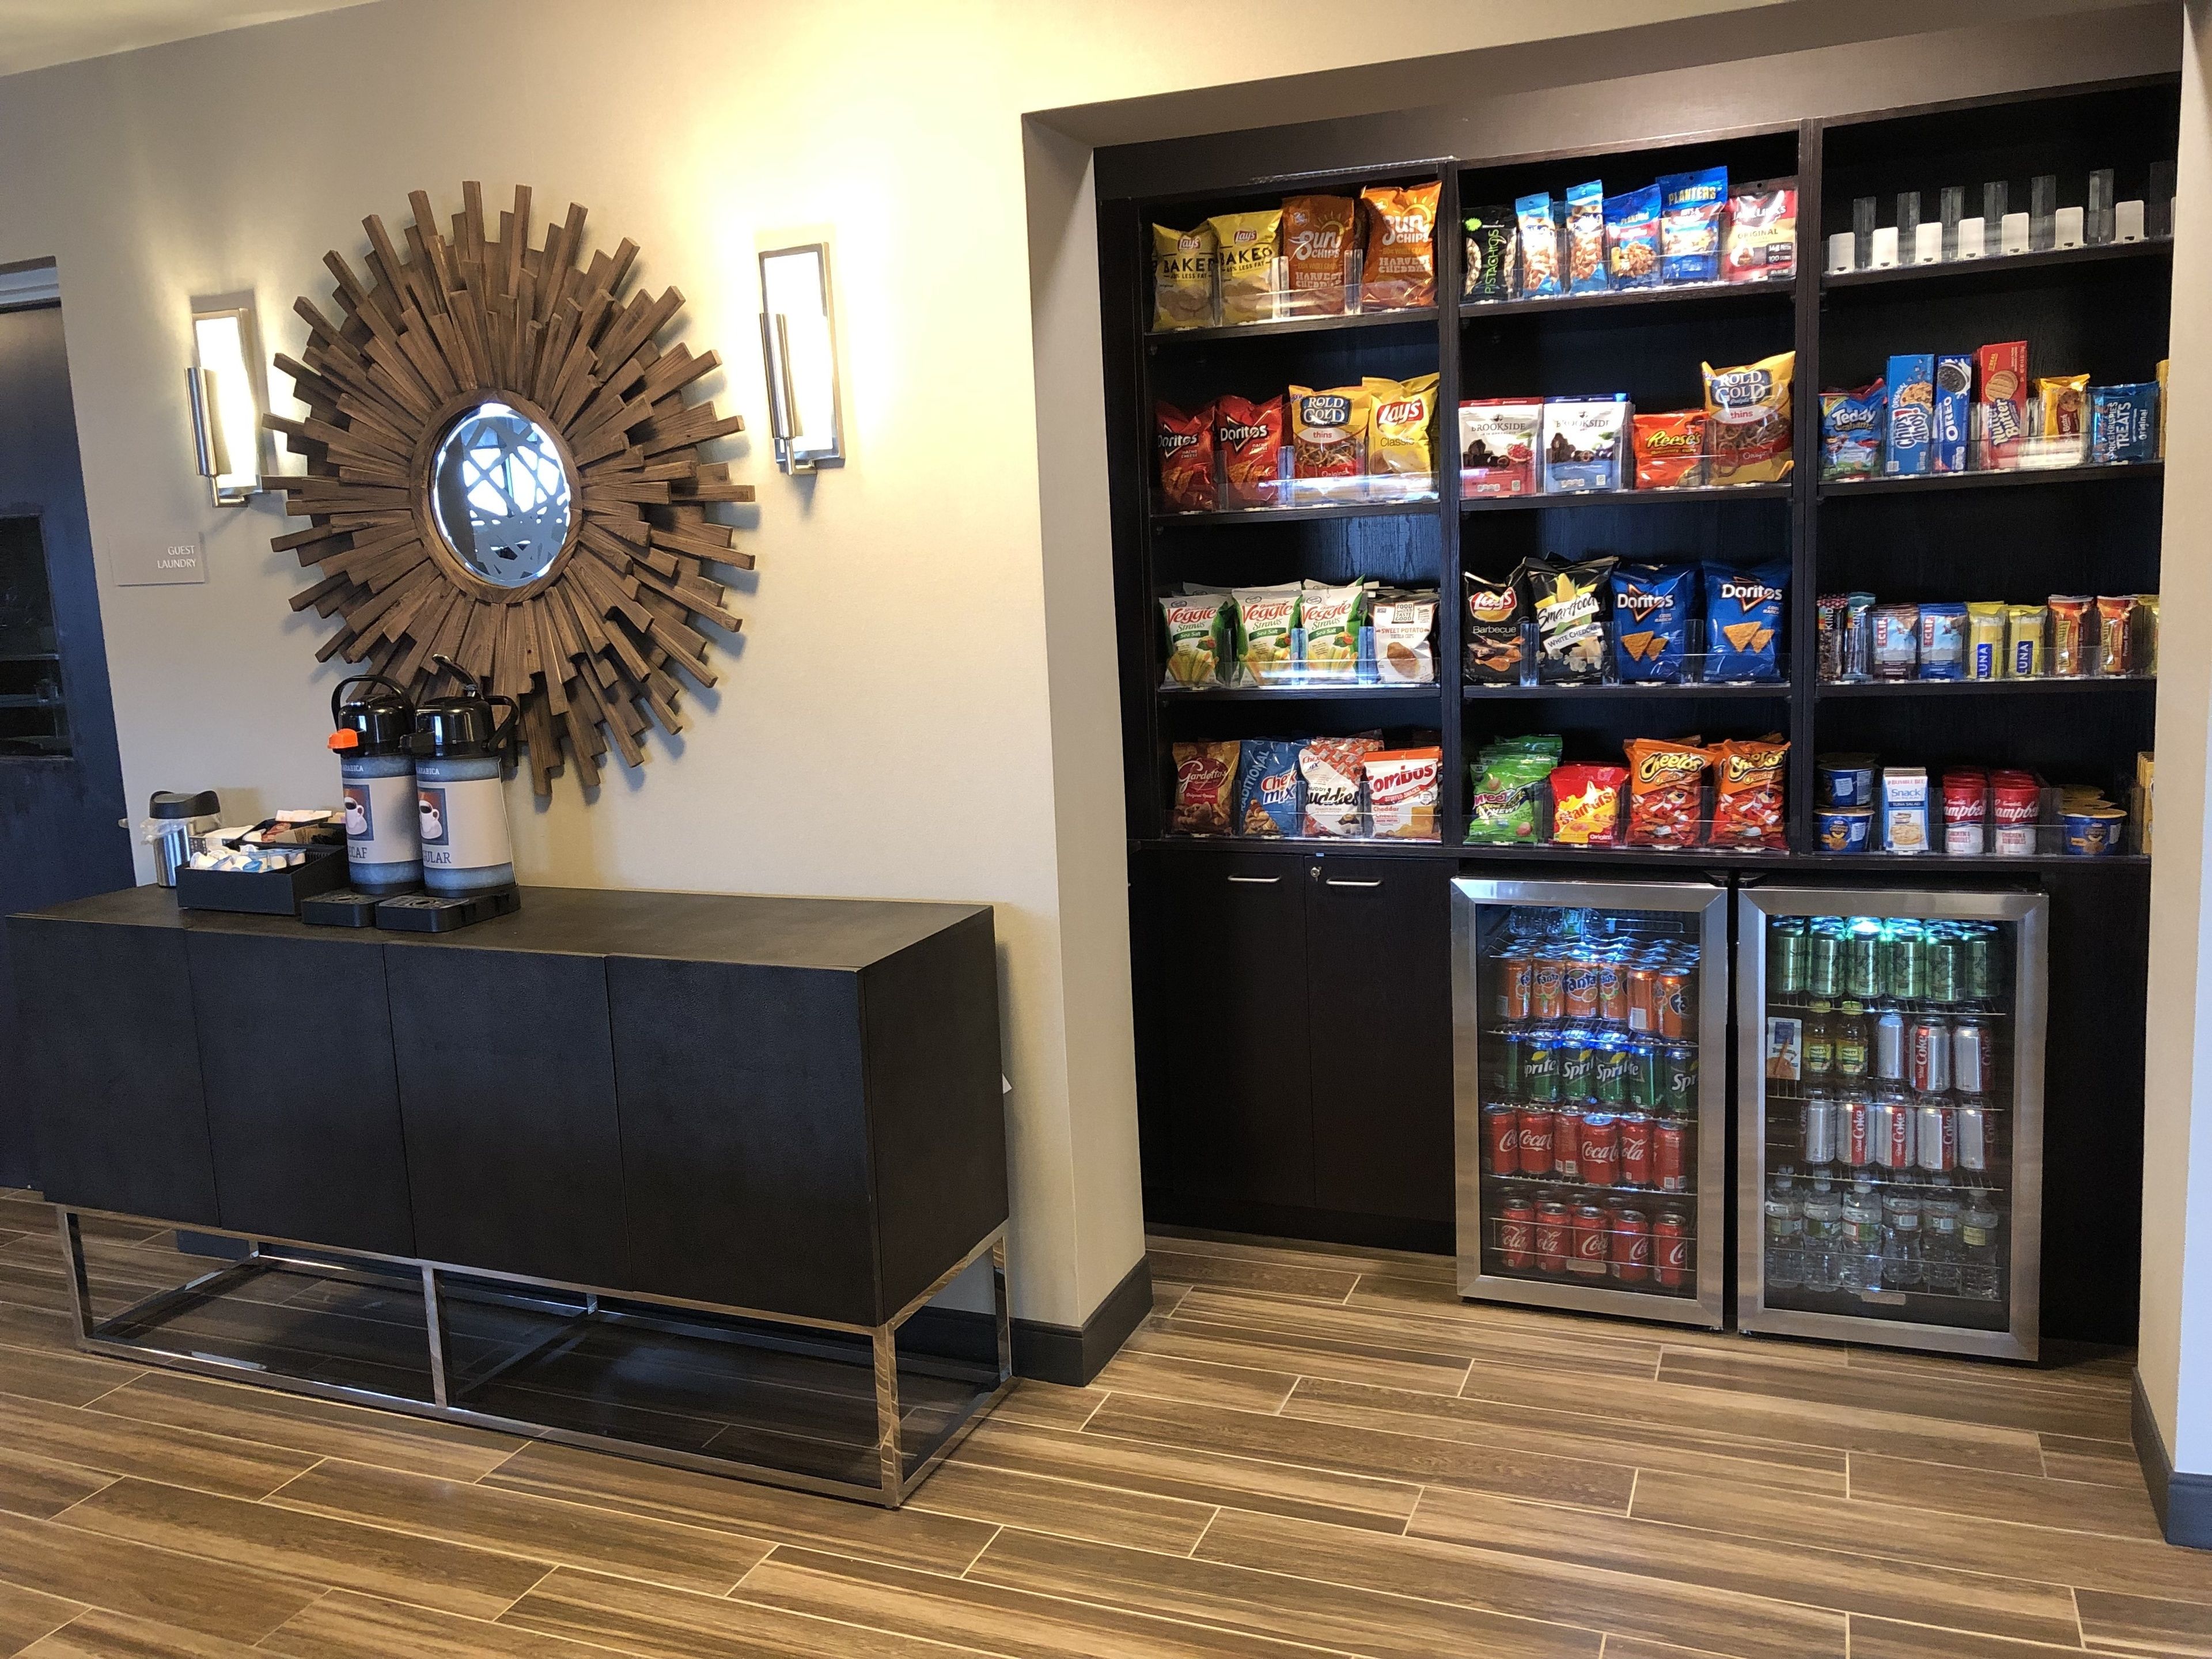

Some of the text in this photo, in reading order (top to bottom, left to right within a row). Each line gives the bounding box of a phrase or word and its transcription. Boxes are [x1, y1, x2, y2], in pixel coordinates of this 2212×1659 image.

[1235, 230, 1256, 243] Lay's
[1382, 214, 1429, 246] Sun
[1395, 232, 1429, 244] CHIPS
[1737, 229, 1778, 239] ORIGINAL
[1179, 237, 1200, 250] Lay's
[1296, 230, 1342, 261] Sun
[1311, 249, 1340, 259] CHIPS
[1720, 370, 1762, 387] ROLD
[1308, 397, 1344, 408] ROLD
[1715, 384, 1766, 404] GOLD
[1304, 408, 1345, 423] GOLD
[1378, 402, 1421, 426] Lay's
[1556, 419, 1610, 428] BOOKSID
[1730, 410, 1753, 418] thins
[1832, 407, 1876, 426] Teddy
[1944, 396, 1959, 441] OREO
[1996, 397, 2020, 438] Butter
[1221, 425, 1267, 442] Doritos
[1471, 422, 1525, 432] BROOKSIDE
[2116, 402, 2132, 449] TREATS
[2138, 409, 2150, 440] Original
[1158, 433, 1198, 448] Doritos
[1380, 437, 1415, 447] Classic
[167, 546, 195, 555] GUEST
[157, 559, 196, 569] LAUNDRY
[1617, 593, 1674, 608] Doritos
[1721, 584, 1782, 600] Doritos
[1166, 607, 1217, 626] Veggie
[1241, 604, 1294, 624] Veggie
[1301, 602, 1351, 624] Veggie
[1825, 608, 1834, 630] KIND
[1473, 626, 1517, 634] Barbecue
[1547, 635, 1569, 648] WHITE
[1978, 646, 1988, 677] LUNA
[2018, 643, 2029, 674] LUNA
[1642, 752, 1703, 781] Cheetos
[1262, 770, 1297, 791] Chex
[1263, 783, 1296, 805] mix
[1891, 789, 1921, 797] Snack
[1562, 973, 1596, 994] Fanta
[1600, 974, 1617, 983] anta
[1916, 1035, 1927, 1065] Coke
[1562, 1058, 1594, 1081] Spri
[1596, 1059, 1628, 1082] Spri
[1672, 1073, 1697, 1091] Spr
[1852, 1109, 1865, 1139] Coke
[1893, 1112, 1906, 1143] Coke
[1943, 1115, 1953, 1145] Coke
